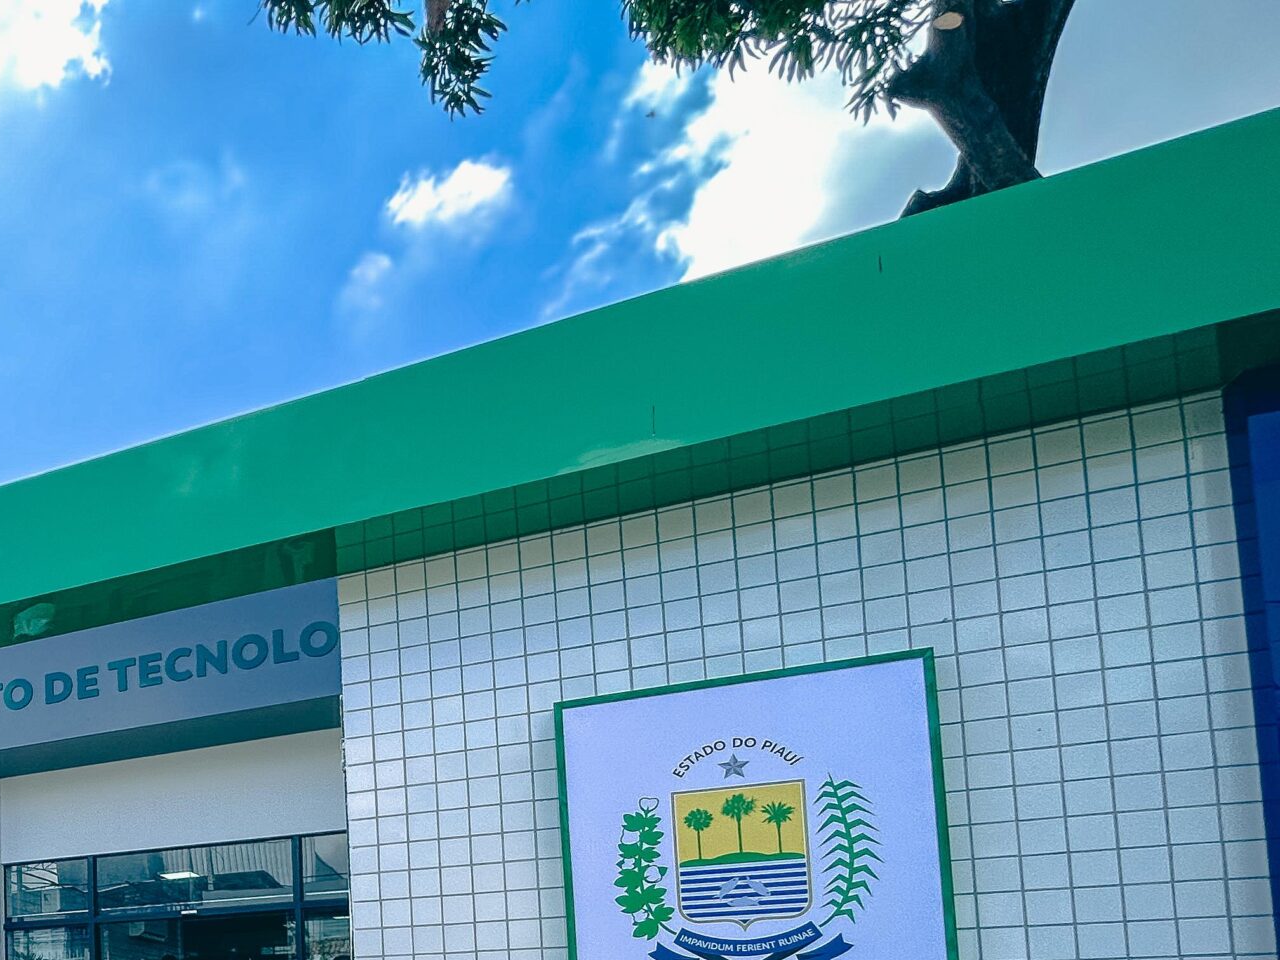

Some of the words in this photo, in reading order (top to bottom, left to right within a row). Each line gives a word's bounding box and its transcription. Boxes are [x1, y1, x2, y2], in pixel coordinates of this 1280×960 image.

[44, 665, 100, 705] DE
[108, 620, 340, 692] TECNOLO
[672, 740, 726, 778] ESTADO
[732, 737, 757, 748] DO
[761, 739, 805, 766] PIAUÍ
[679, 934, 734, 952] IMPAVIDUM
[736, 942, 775, 952] FERIENT
[778, 928, 816, 947] RUINAE
